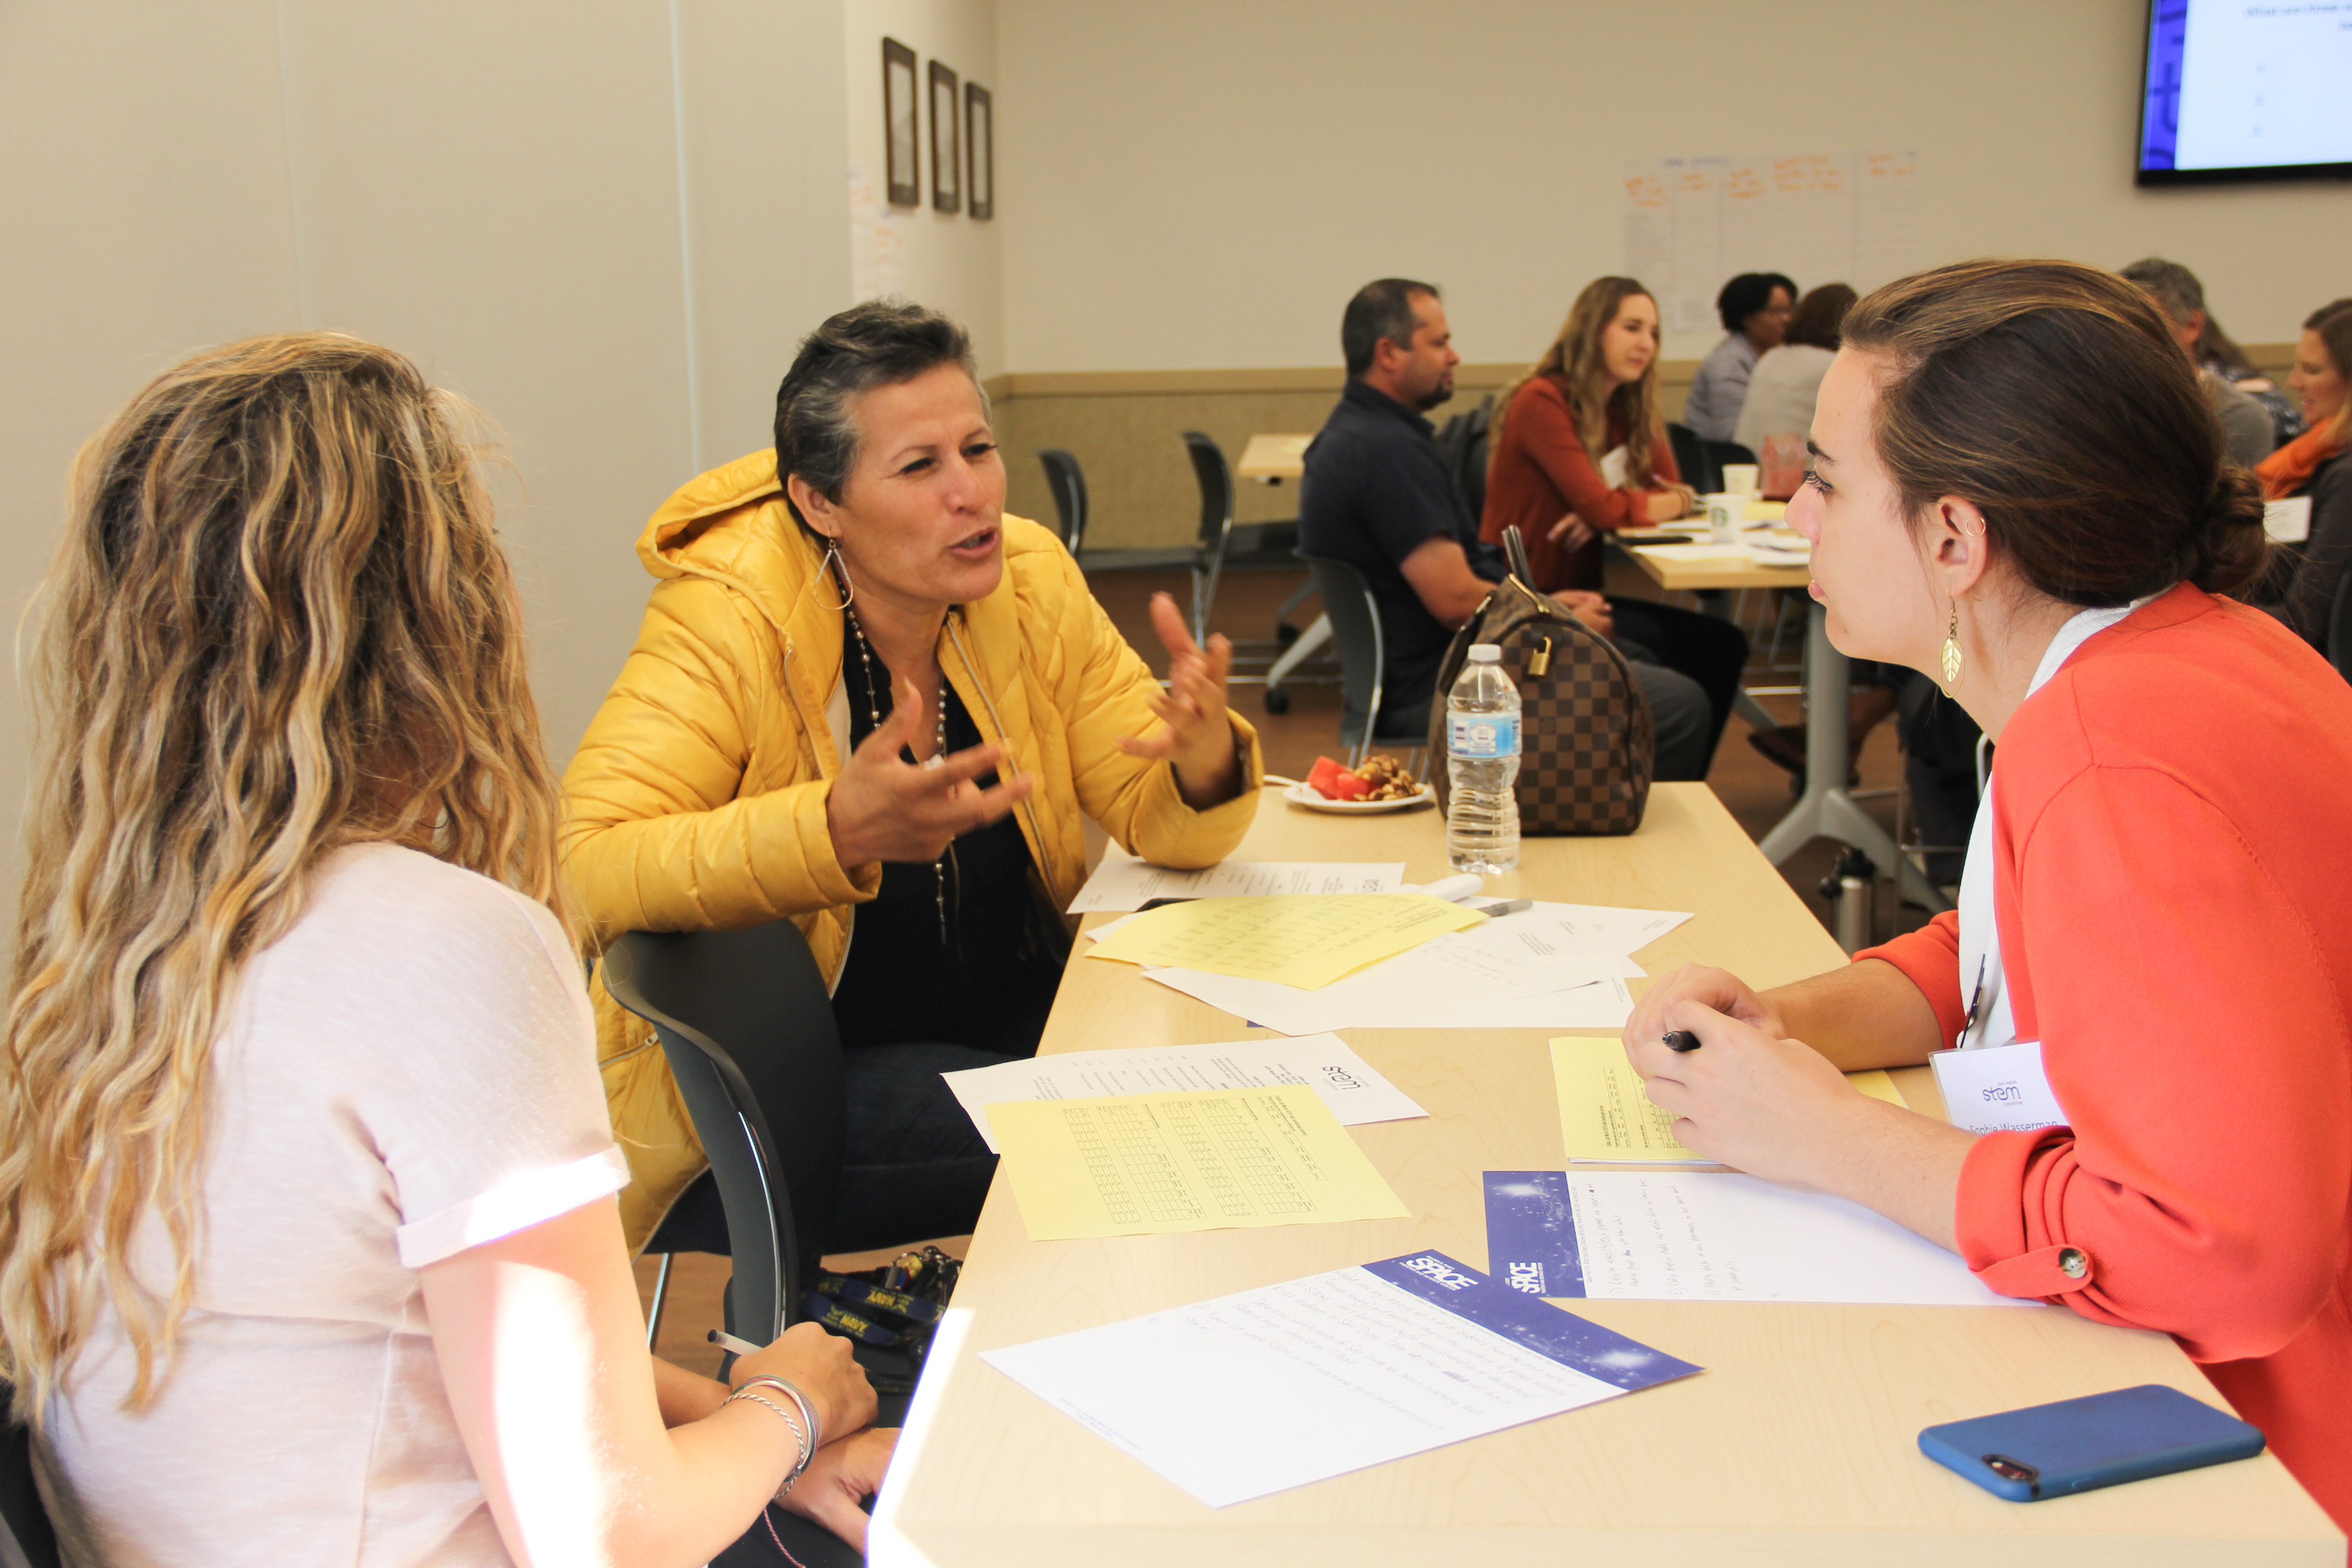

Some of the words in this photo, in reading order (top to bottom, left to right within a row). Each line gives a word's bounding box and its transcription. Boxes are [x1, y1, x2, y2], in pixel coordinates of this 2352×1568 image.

[1322, 1065, 1362, 1090] stem
[1982, 1086, 2022, 1102] stem
[1405, 1255, 1478, 1290] SPACE
[1509, 1262, 1541, 1294] SPACE
[840, 1314, 868, 1333] NAVY
